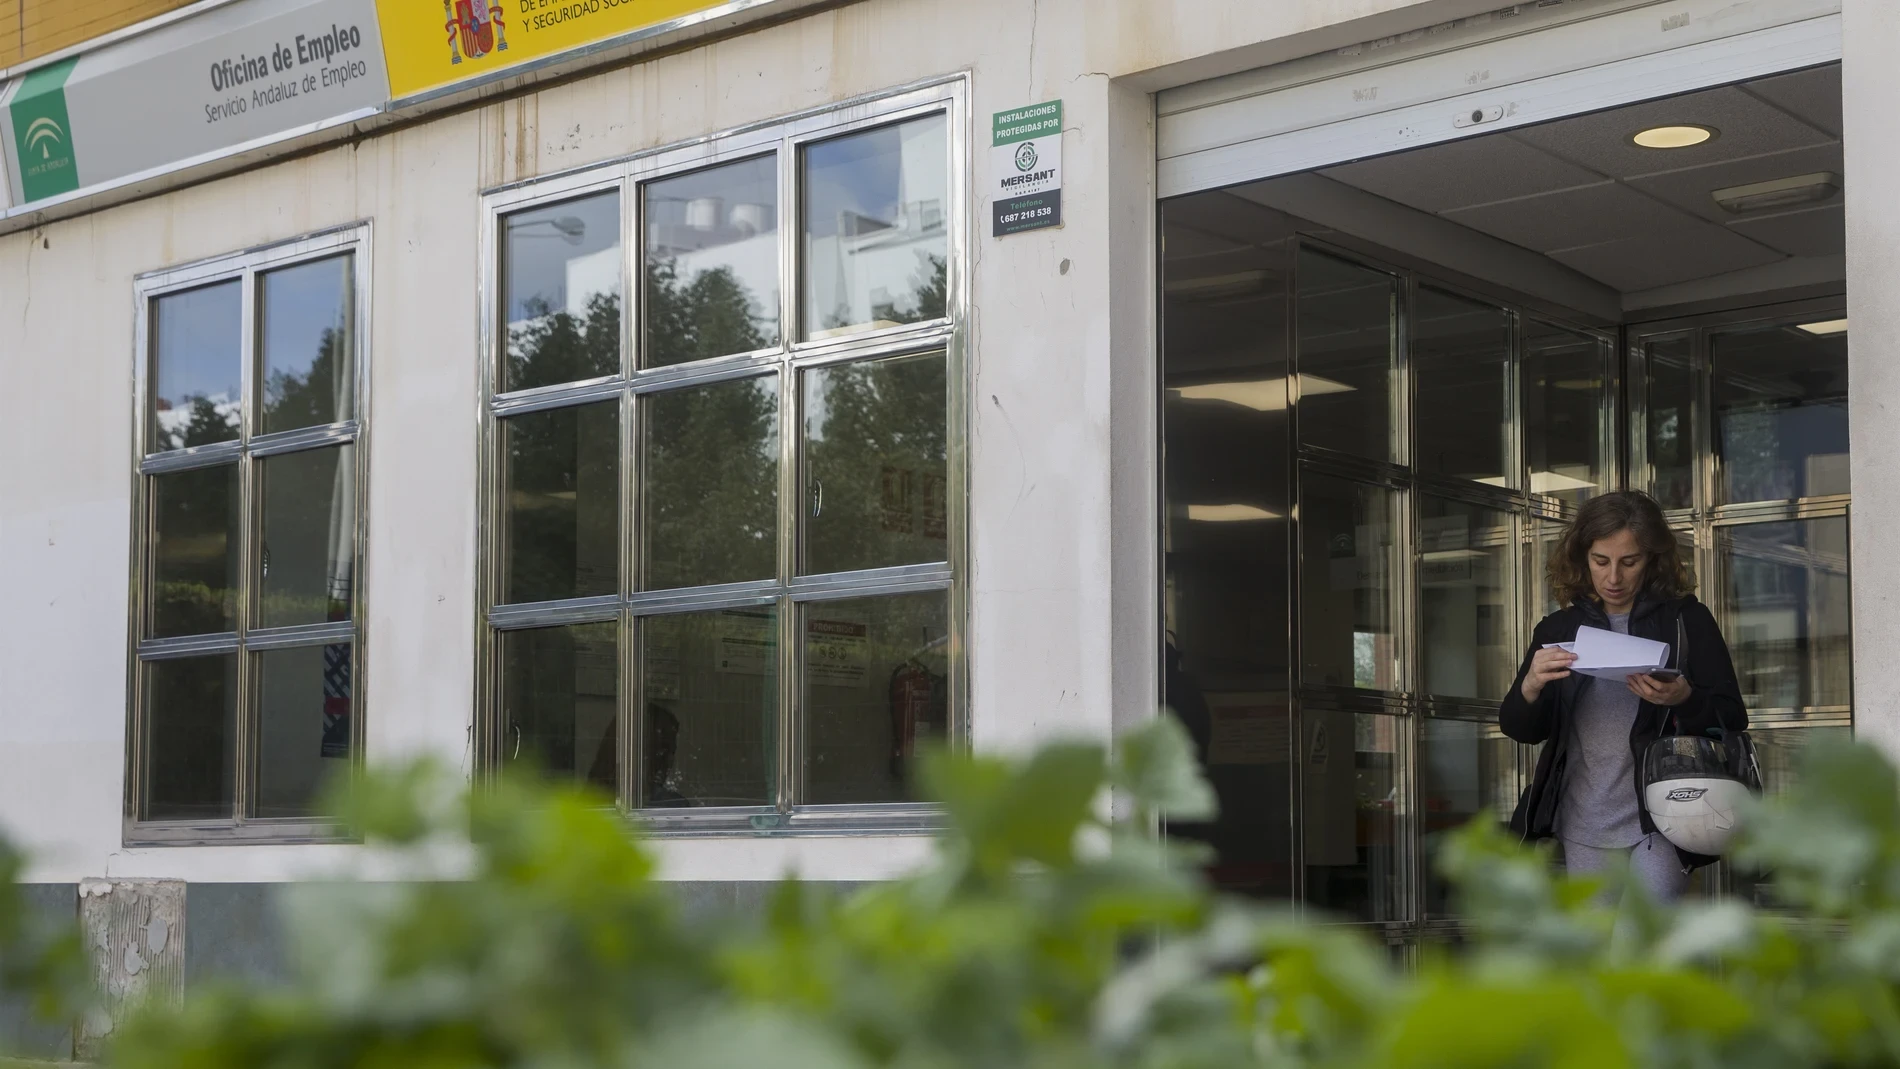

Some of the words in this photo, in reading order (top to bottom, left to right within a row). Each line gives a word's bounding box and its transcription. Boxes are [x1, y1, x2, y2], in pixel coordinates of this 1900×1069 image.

[520, 0, 536, 13] DE
[522, 18, 530, 33] Y
[533, 0, 600, 30] SEGURIDAD
[210, 54, 269, 92] Oficina
[272, 43, 293, 73] de
[295, 24, 361, 64] Empleo
[205, 95, 247, 124] Servicio
[252, 81, 298, 109] Andaluz
[302, 73, 317, 94] de
[321, 60, 366, 88] Empleo
[998, 104, 1057, 124] INSTALACIONES
[996, 121, 1042, 139] PROTEGIDAS
[1043, 118, 1059, 129] POR
[1000, 168, 1056, 188] MERSANT
[1004, 212, 1019, 223] 687
[1020, 209, 1035, 220] 218
[1037, 206, 1052, 217] 538
